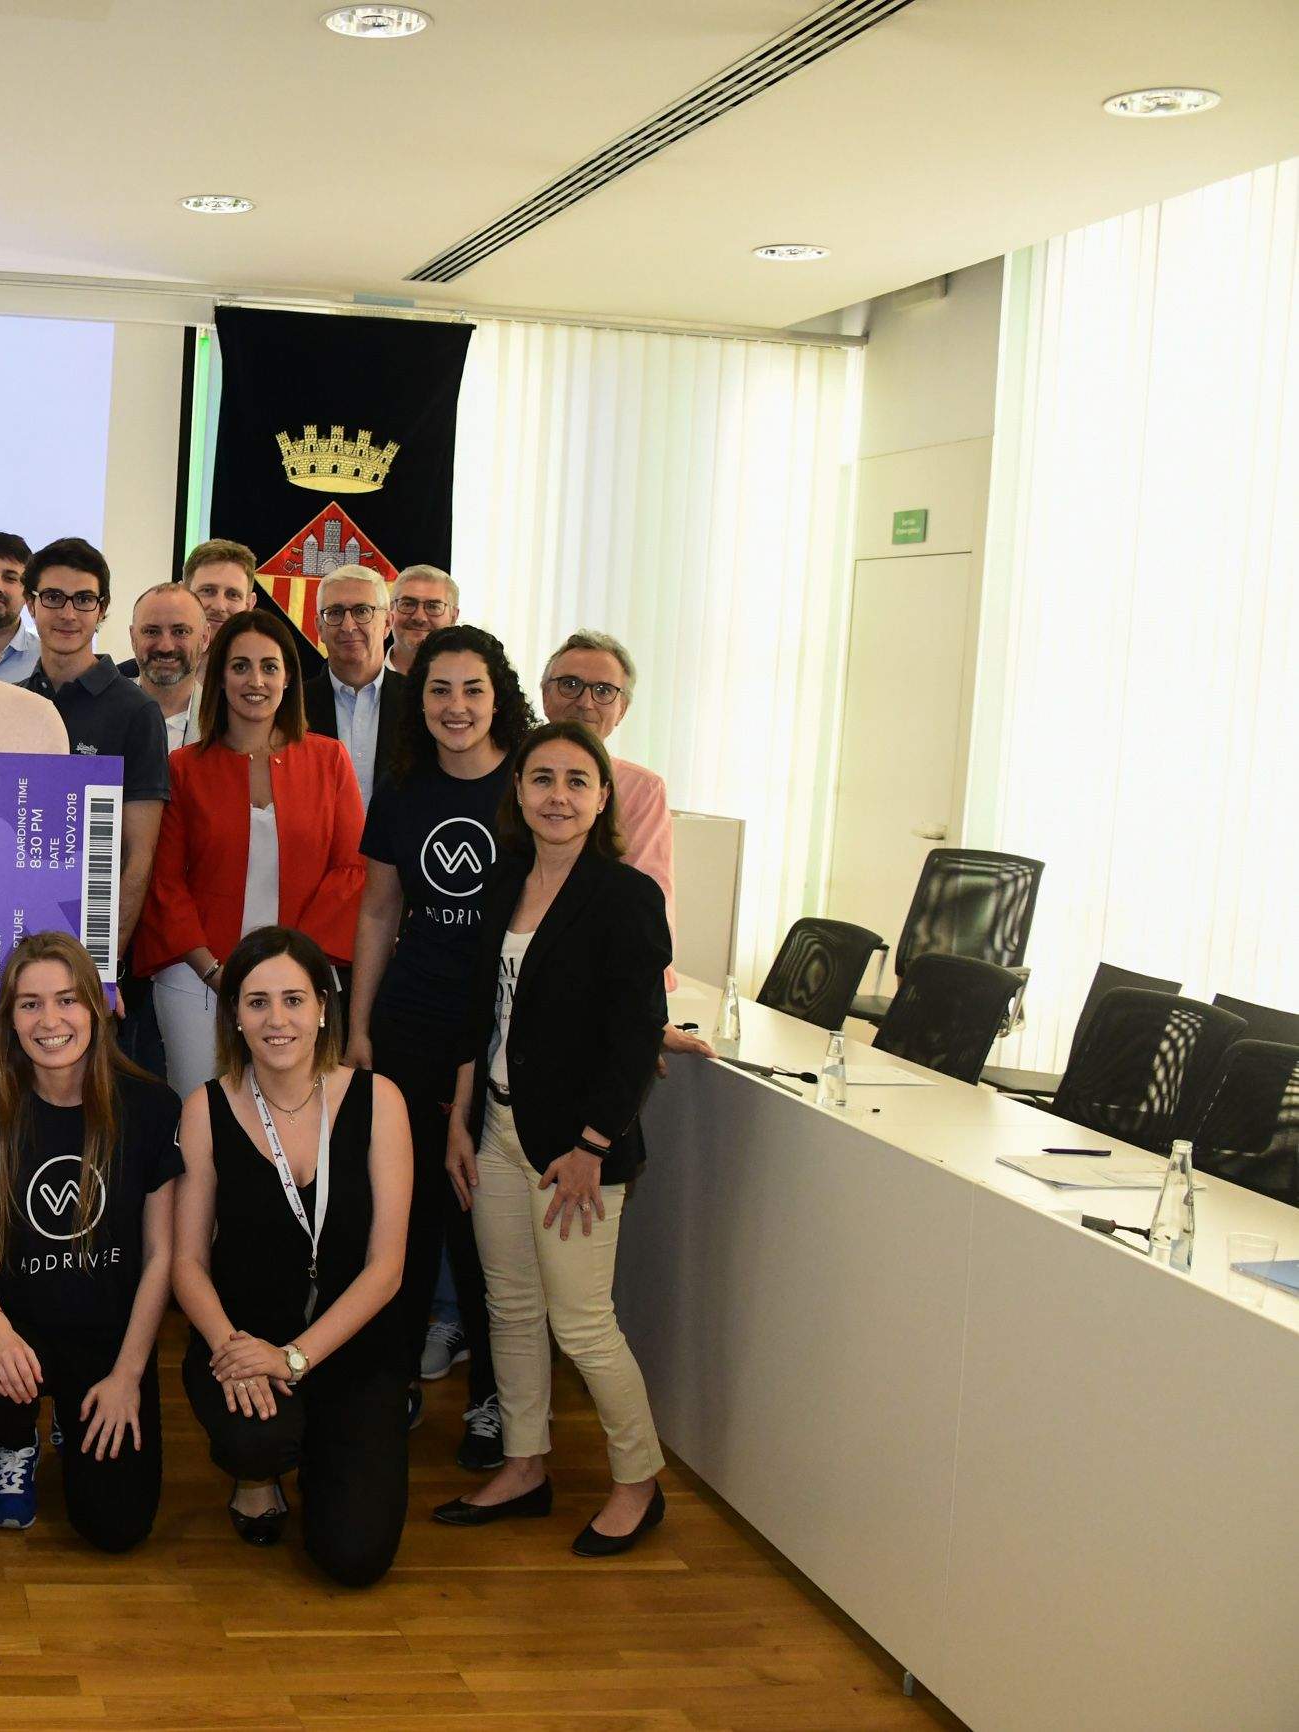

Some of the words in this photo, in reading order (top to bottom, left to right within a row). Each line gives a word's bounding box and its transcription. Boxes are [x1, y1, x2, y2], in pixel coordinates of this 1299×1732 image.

[18, 778, 28, 805] TIME
[31, 809, 43, 832] PM
[67, 793, 77, 822] 2018
[16, 807, 27, 868] BOARDING
[66, 825, 76, 854] NOV
[29, 837, 42, 868] 8:30
[49, 838, 60, 868] DATE
[65, 857, 75, 870] 15
